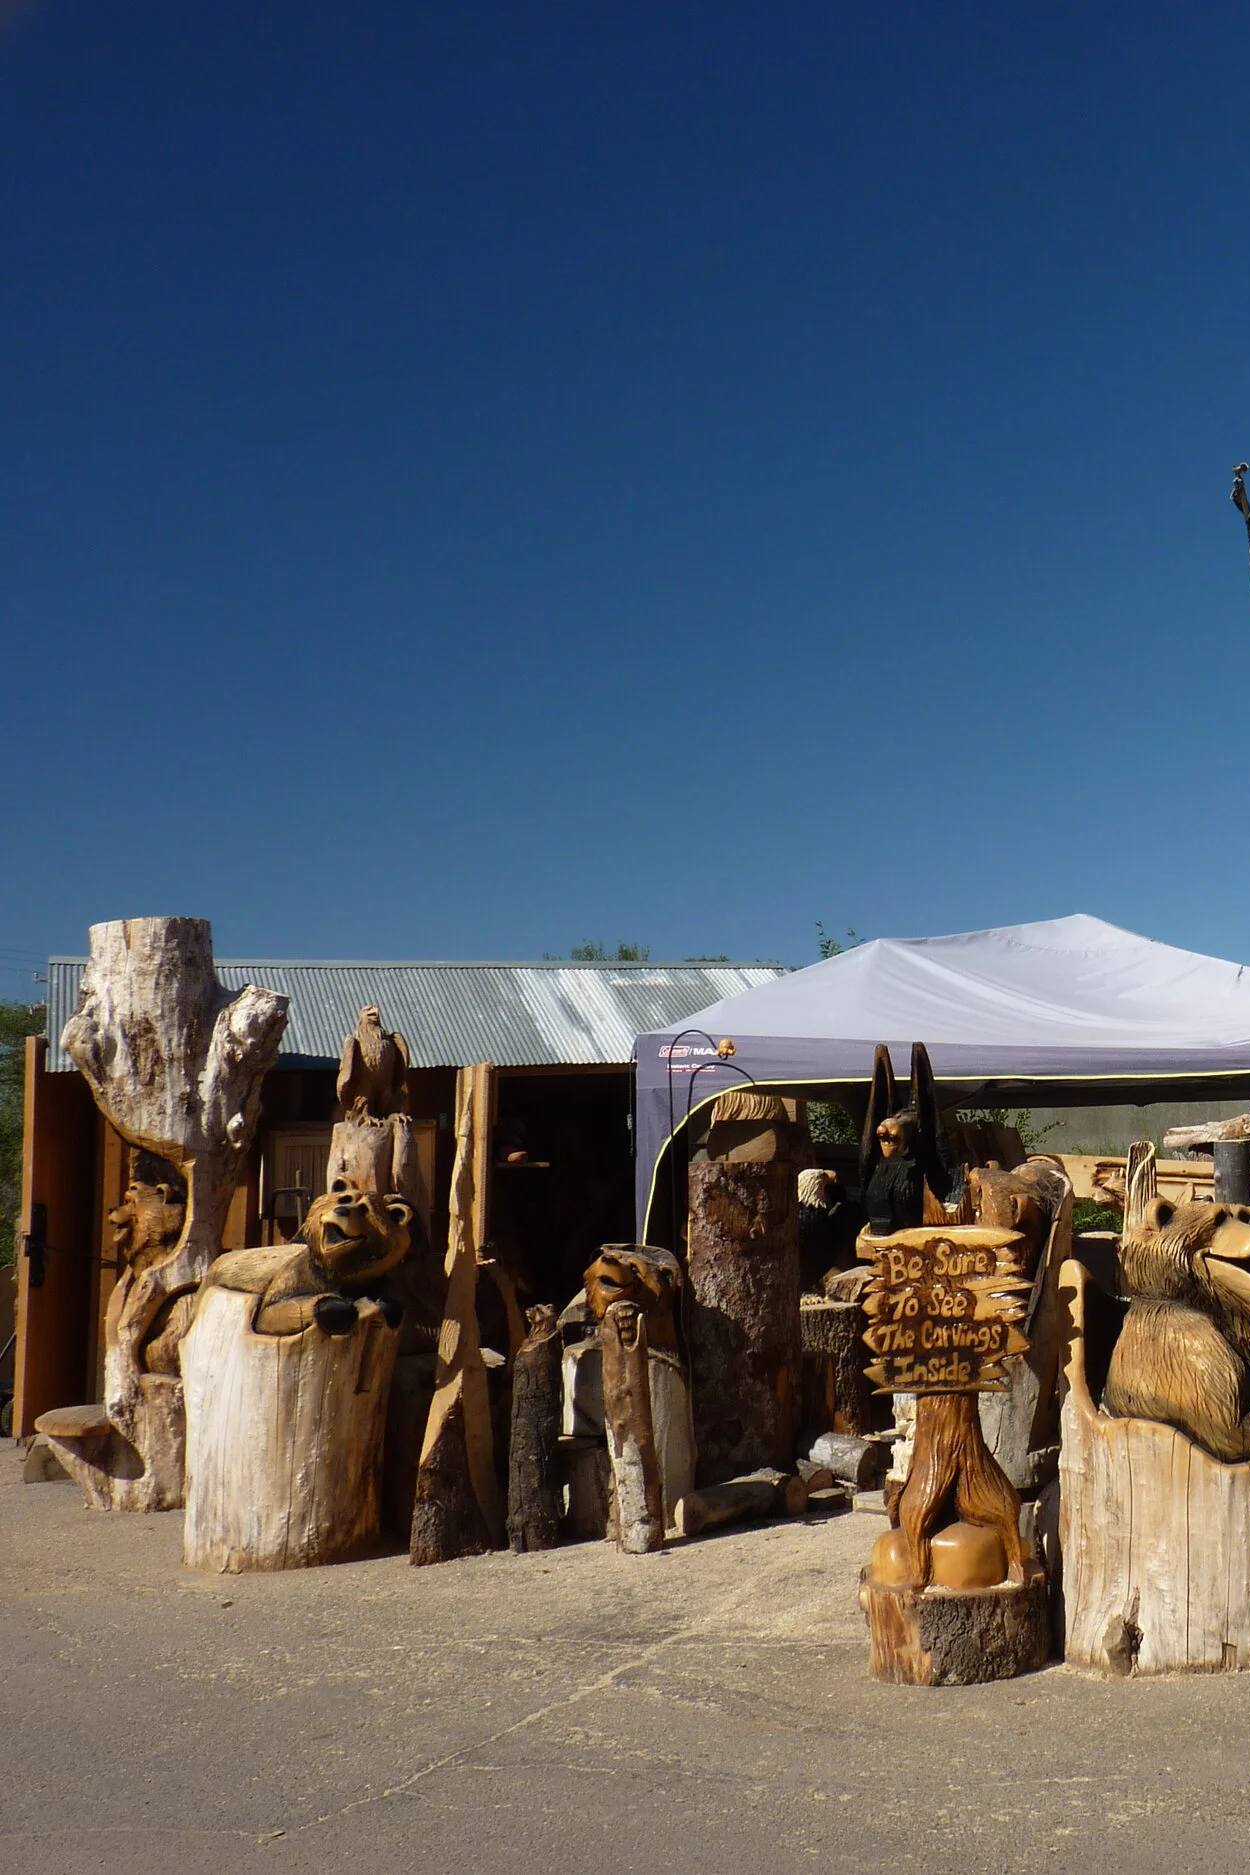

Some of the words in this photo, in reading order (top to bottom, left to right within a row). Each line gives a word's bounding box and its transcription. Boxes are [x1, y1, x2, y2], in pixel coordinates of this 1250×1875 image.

[888, 1250, 923, 1286] Be
[933, 1242, 988, 1277] Sure
[887, 1287, 919, 1321] To
[927, 1286, 968, 1318] See
[877, 1323, 916, 1350] The
[921, 1320, 1003, 1353] Carvings
[893, 1352, 972, 1383] Inside
